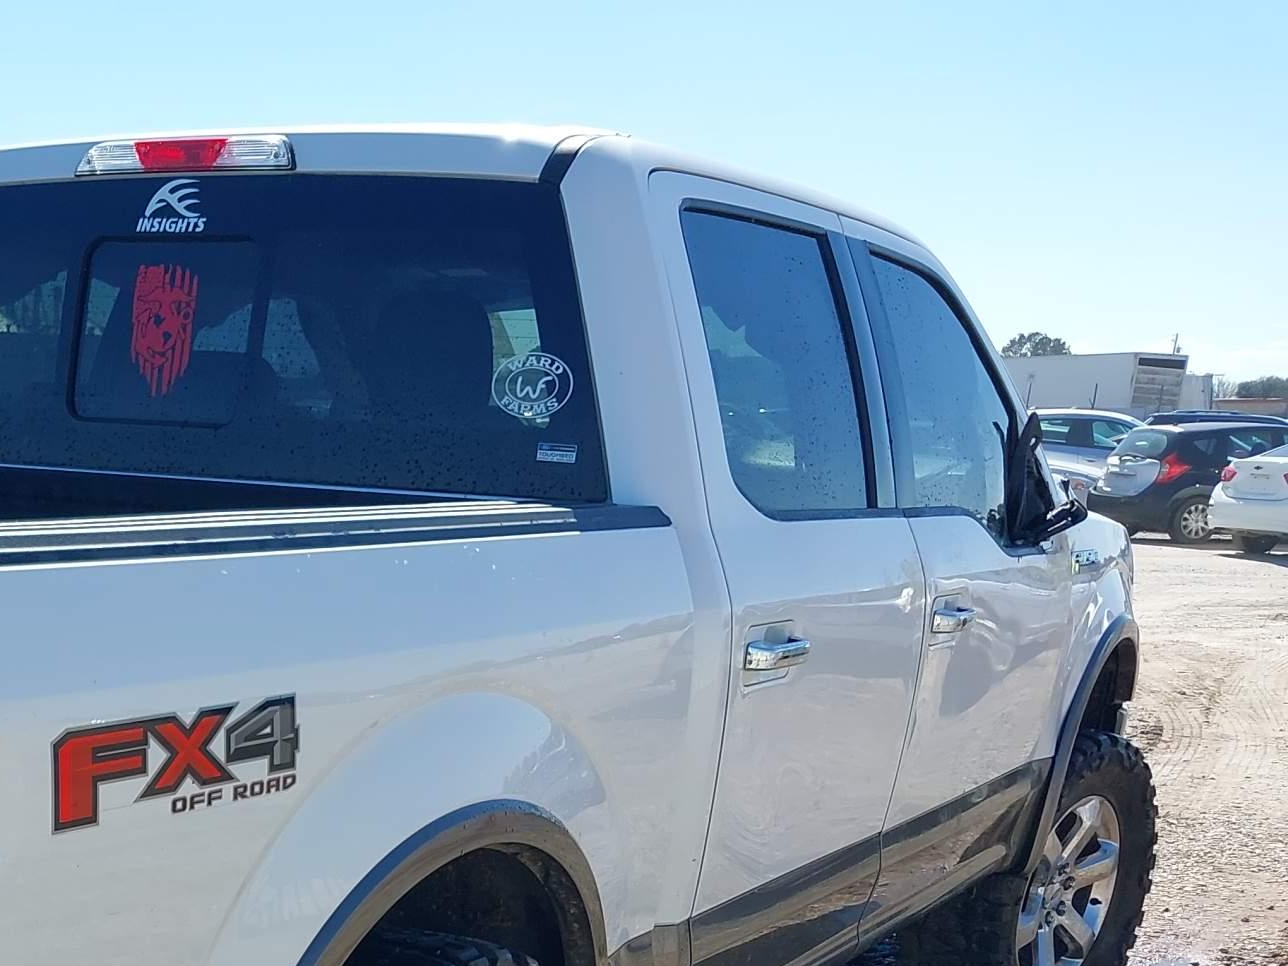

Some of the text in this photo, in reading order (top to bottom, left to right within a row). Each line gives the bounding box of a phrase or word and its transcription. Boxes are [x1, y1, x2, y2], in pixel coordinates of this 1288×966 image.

[135, 217, 207, 233] INSIGHTS
[507, 355, 564, 375] WARD
[500, 397, 559, 415] FARMS
[51, 692, 299, 835] FX4
[171, 773, 297, 814] OFF ROAD
